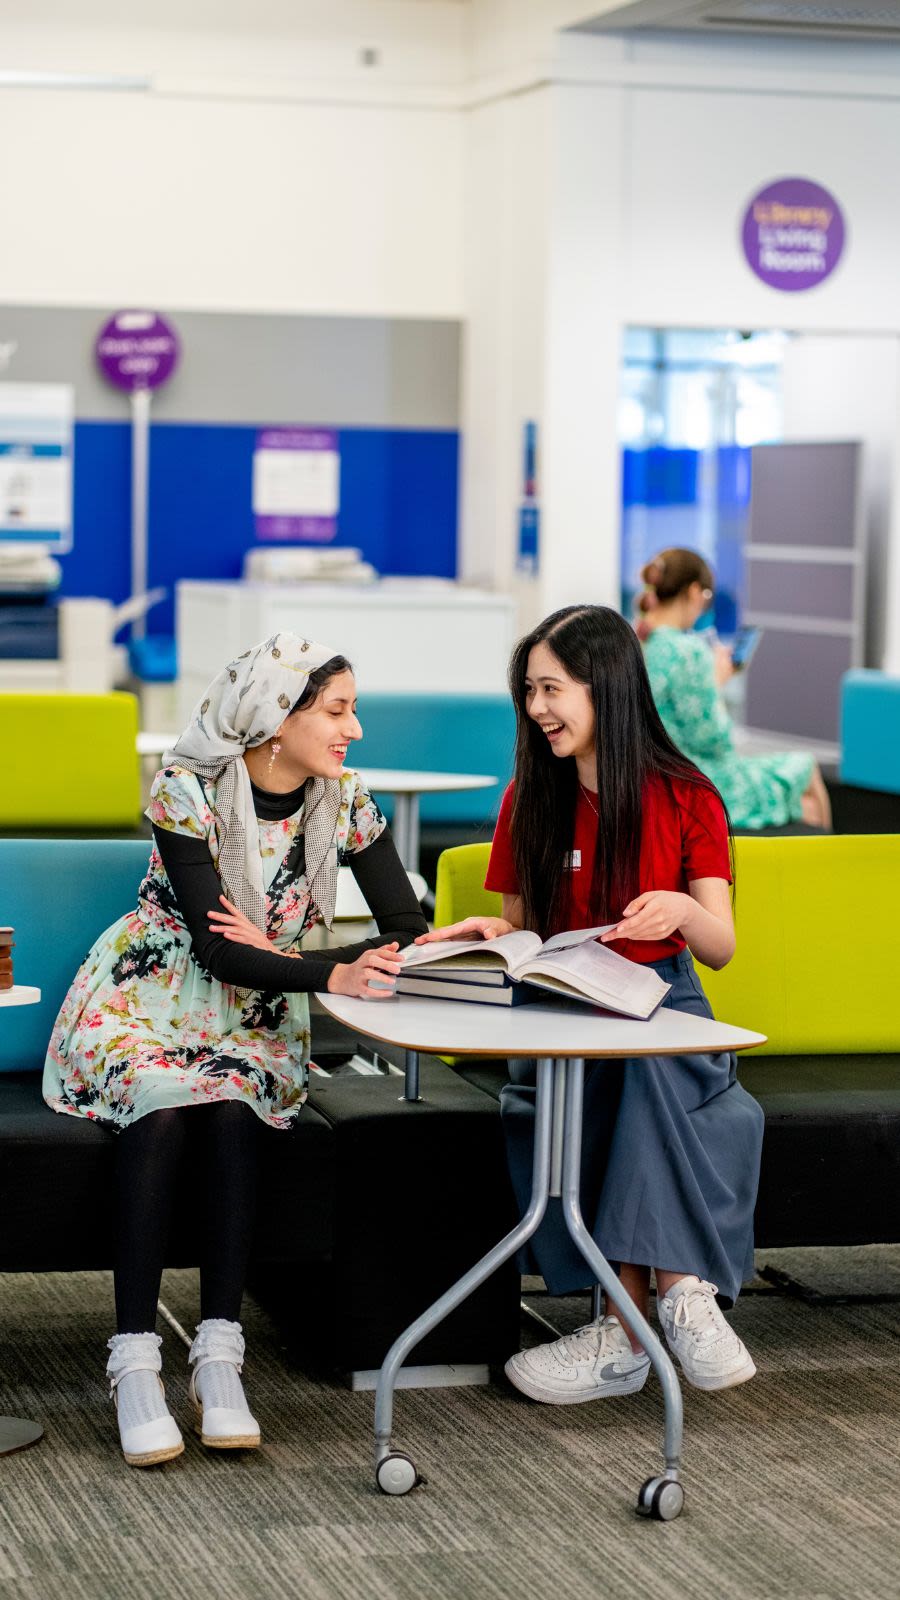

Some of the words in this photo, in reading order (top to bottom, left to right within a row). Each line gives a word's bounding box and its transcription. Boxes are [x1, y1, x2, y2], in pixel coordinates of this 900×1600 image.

[754, 202, 831, 230] Library
[758, 226, 827, 252] Living
[759, 249, 826, 272] Room
